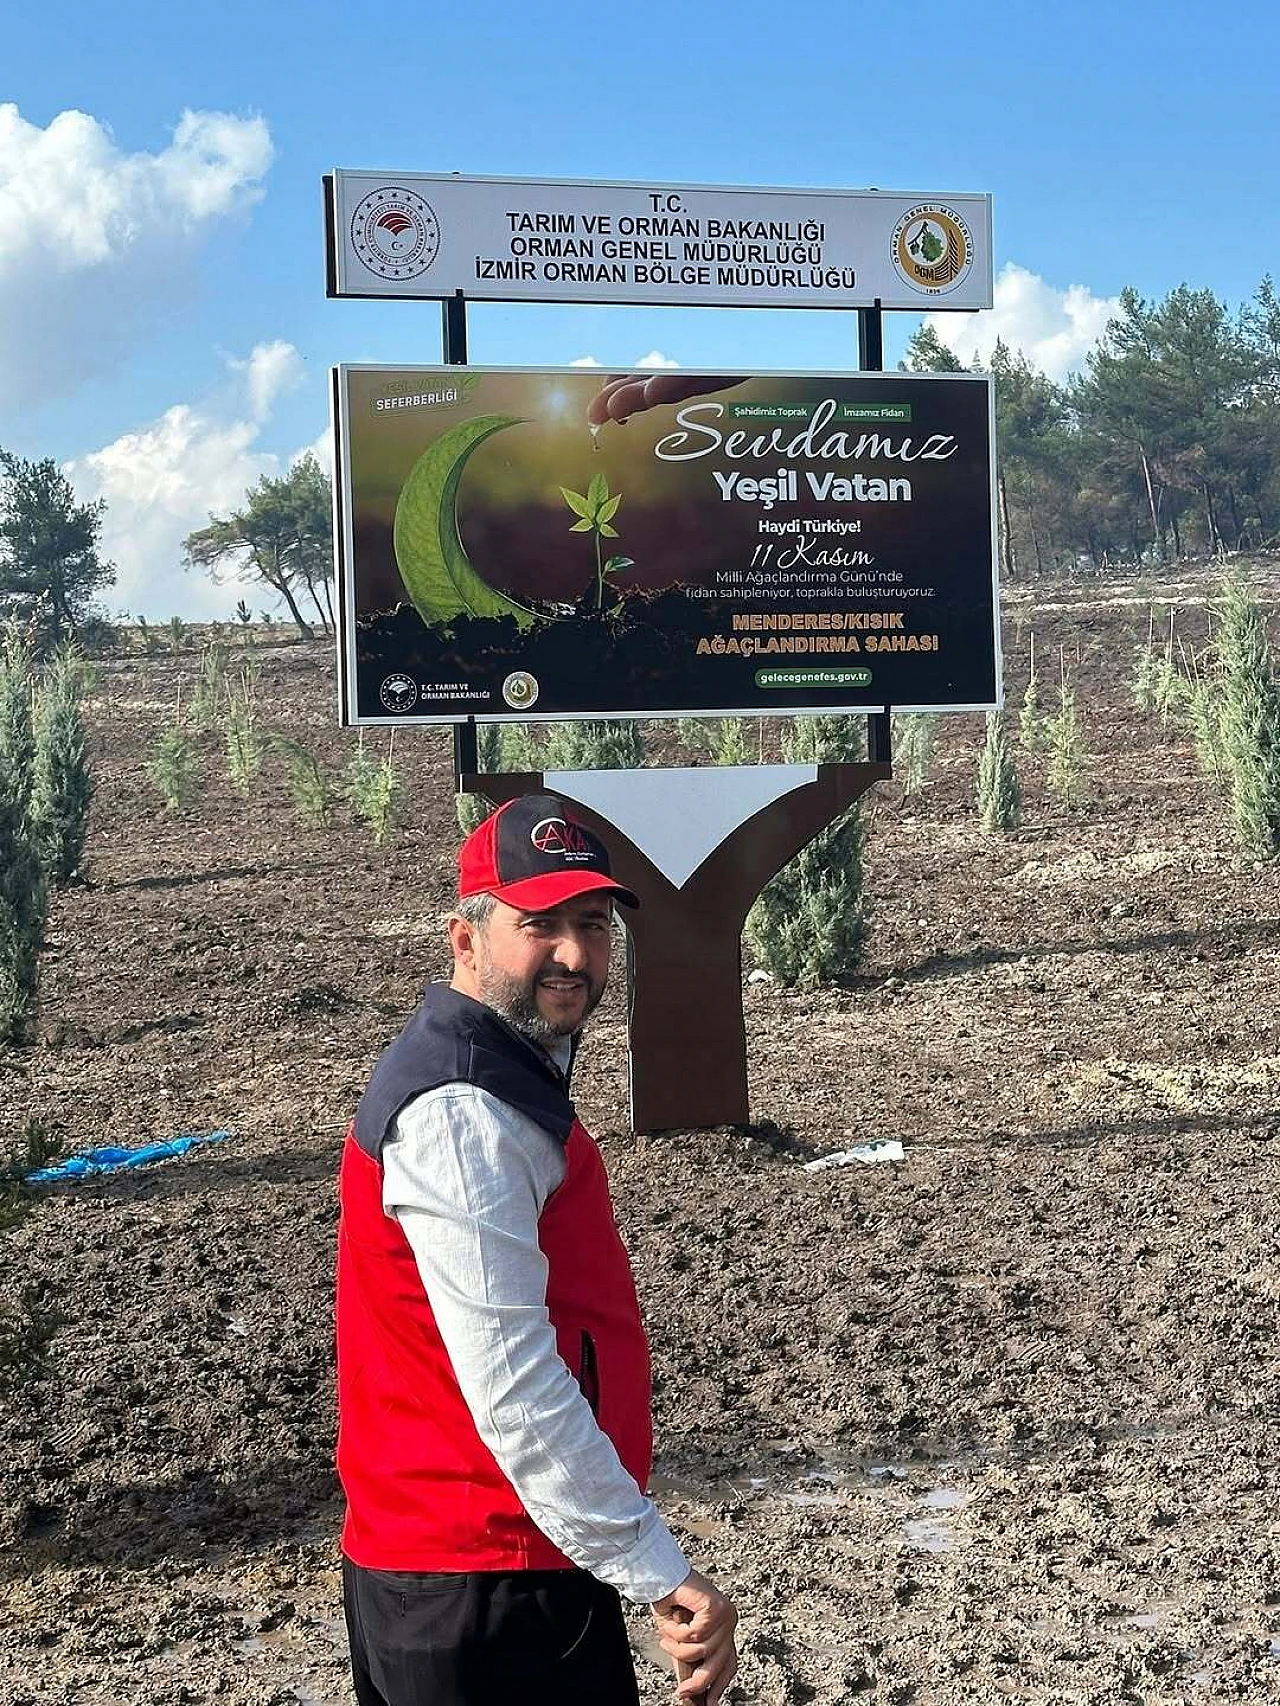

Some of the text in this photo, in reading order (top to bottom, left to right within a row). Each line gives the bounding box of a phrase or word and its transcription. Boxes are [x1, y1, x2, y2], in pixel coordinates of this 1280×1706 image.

[649, 193, 687, 214] T.C.
[505, 212, 826, 242] TARIM VE ORMAN BAKANLIĞI
[510, 236, 822, 265] ORMAN GENEL MÜDÜRLÜĞÜ
[475, 255, 856, 289] İZMİR ORMAN BÖLGE MÜDÜRLÜĞÜ
[734, 406, 808, 419] Şahidimiz Toprak
[881, 407, 905, 418] Fidan
[654, 398, 958, 462] Sevdamız
[711, 468, 912, 510] Yeşil Vatan
[758, 518, 862, 536] Haydi Türkiye!
[750, 535, 875, 569] 11 Kasım
[716, 570, 904, 586] Milli Ağaçlandırma Günü'nde
[686, 587, 717, 599] fidan
[796, 588, 844, 600] toprakla
[732, 612, 905, 631] MENDERES/KISIK
[696, 634, 940, 657] AĞAÇLANDIRMA SAHASI
[435, 683, 458, 691] TARIM
[459, 683, 469, 691] VE
[759, 671, 869, 686] gelecegenefes.gov.tr
[421, 691, 449, 700] ORMAN
